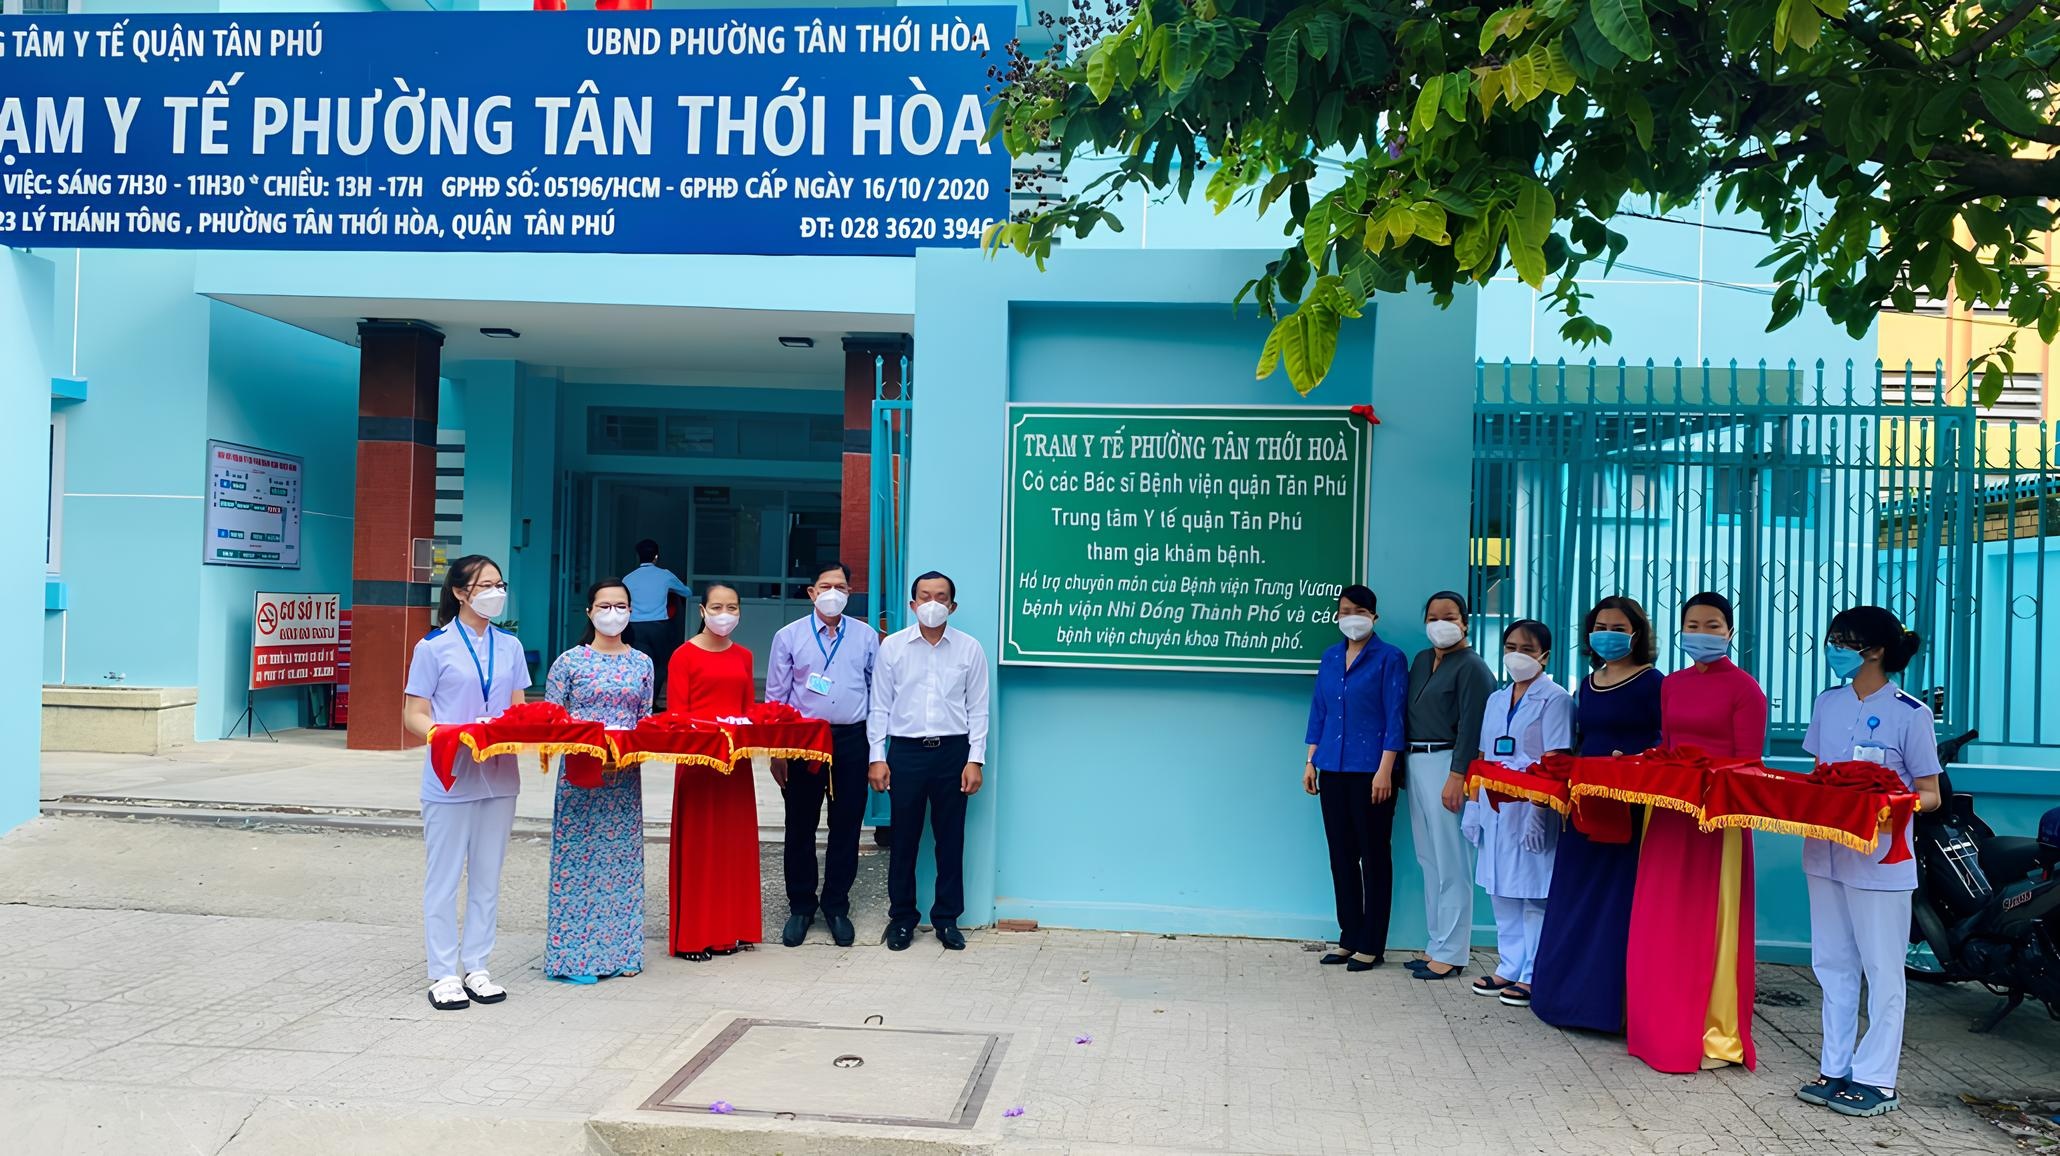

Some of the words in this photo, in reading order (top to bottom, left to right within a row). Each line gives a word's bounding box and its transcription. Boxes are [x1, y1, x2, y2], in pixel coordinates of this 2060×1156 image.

[12, 24, 64, 56] TÂM
[74, 31, 89, 57] Y
[96, 19, 129, 56] TẾ
[133, 23, 203, 62] QUẬN
[213, 22, 261, 56] TÂN
[271, 22, 322, 56] PHÚ
[588, 28, 660, 55] UBND
[671, 20, 784, 55] PHƯỜNG
[795, 18, 845, 53] TÂN
[856, 16, 919, 52] THỚI
[931, 16, 990, 51] HÒA
[104, 97, 141, 153] Y
[164, 72, 244, 154] TẾ
[253, 78, 512, 155] PHƯỜNG
[535, 80, 652, 155] TÂN
[678, 77, 825, 156] THỚI
[853, 77, 991, 155] HÒA
[4, 169, 51, 199] VIỆC:
[58, 169, 111, 194] SÁNG
[118, 175, 166, 194] 7H30
[188, 175, 244, 195] 11H30
[264, 167, 329, 196] CHIỀU:
[336, 177, 371, 196] 13H
[442, 177, 500, 197] GPHĐ
[506, 167, 539, 197] SỐ:
[545, 177, 660, 200] 05196/HCM
[680, 178, 738, 198] GPHĐ
[746, 168, 787, 198] CẤP
[795, 171, 853, 198] NGÀY
[863, 178, 989, 201] 16/10/2020
[23, 205, 46, 231] LÝ
[50, 206, 119, 232] THÁNH
[199, 206, 286, 233] PHƯỜNG
[293, 208, 332, 234] TÂN
[339, 208, 387, 234] THỚI
[395, 208, 444, 237] HÒA,
[452, 208, 511, 240] QUẬN
[524, 209, 564, 235] TÂN
[572, 209, 614, 235] PHÚ
[800, 217, 833, 237] ĐT:
[841, 218, 878, 238] 028
[886, 218, 936, 239] 3620
[1024, 434, 1077, 462] TRẠM
[1083, 435, 1095, 457] Y
[1100, 425, 1125, 458] TẾ
[1131, 429, 1206, 459] PHƯỜNG
[1212, 431, 1249, 459] TÂN
[1256, 431, 1302, 460] THỚI
[1308, 431, 1347, 460] HOÀ
[1023, 470, 1044, 491] Có
[1050, 471, 1078, 491] các
[1084, 472, 1114, 492] Bác
[1140, 472, 1182, 497] Bệnh
[1189, 474, 1222, 498] viện
[1229, 475, 1269, 499] quận
[1276, 475, 1306, 495] Tân
[1314, 475, 1346, 495] Phú
[1052, 508, 1100, 531] Trung
[1107, 509, 1137, 526] tâm
[1144, 510, 1154, 527] Y
[1161, 507, 1176, 528] tế
[1182, 511, 1223, 533] quận
[1231, 511, 1261, 529] Tân
[1269, 512, 1301, 530] Phú
[1088, 542, 1127, 560] tham
[1135, 543, 1158, 566] gia
[1166, 544, 1210, 562] khám
[1218, 545, 1265, 567] bệnh.
[1042, 575, 1061, 592] trợ
[1152, 574, 1176, 593] của
[1181, 577, 1215, 596] Bệnh
[1221, 578, 1248, 597] viện
[1255, 579, 1293, 599] Trưng
[1300, 579, 1343, 600] Vương
[315, 602, 322, 620] Y
[1023, 599, 1062, 618] bệnh
[1070, 601, 1102, 620] viện
[1107, 601, 1135, 617] Nhi
[1248, 603, 1283, 622] Phố
[1057, 626, 1091, 645] bệnh
[1097, 627, 1125, 646] viện
[1271, 630, 1303, 652] phố.
